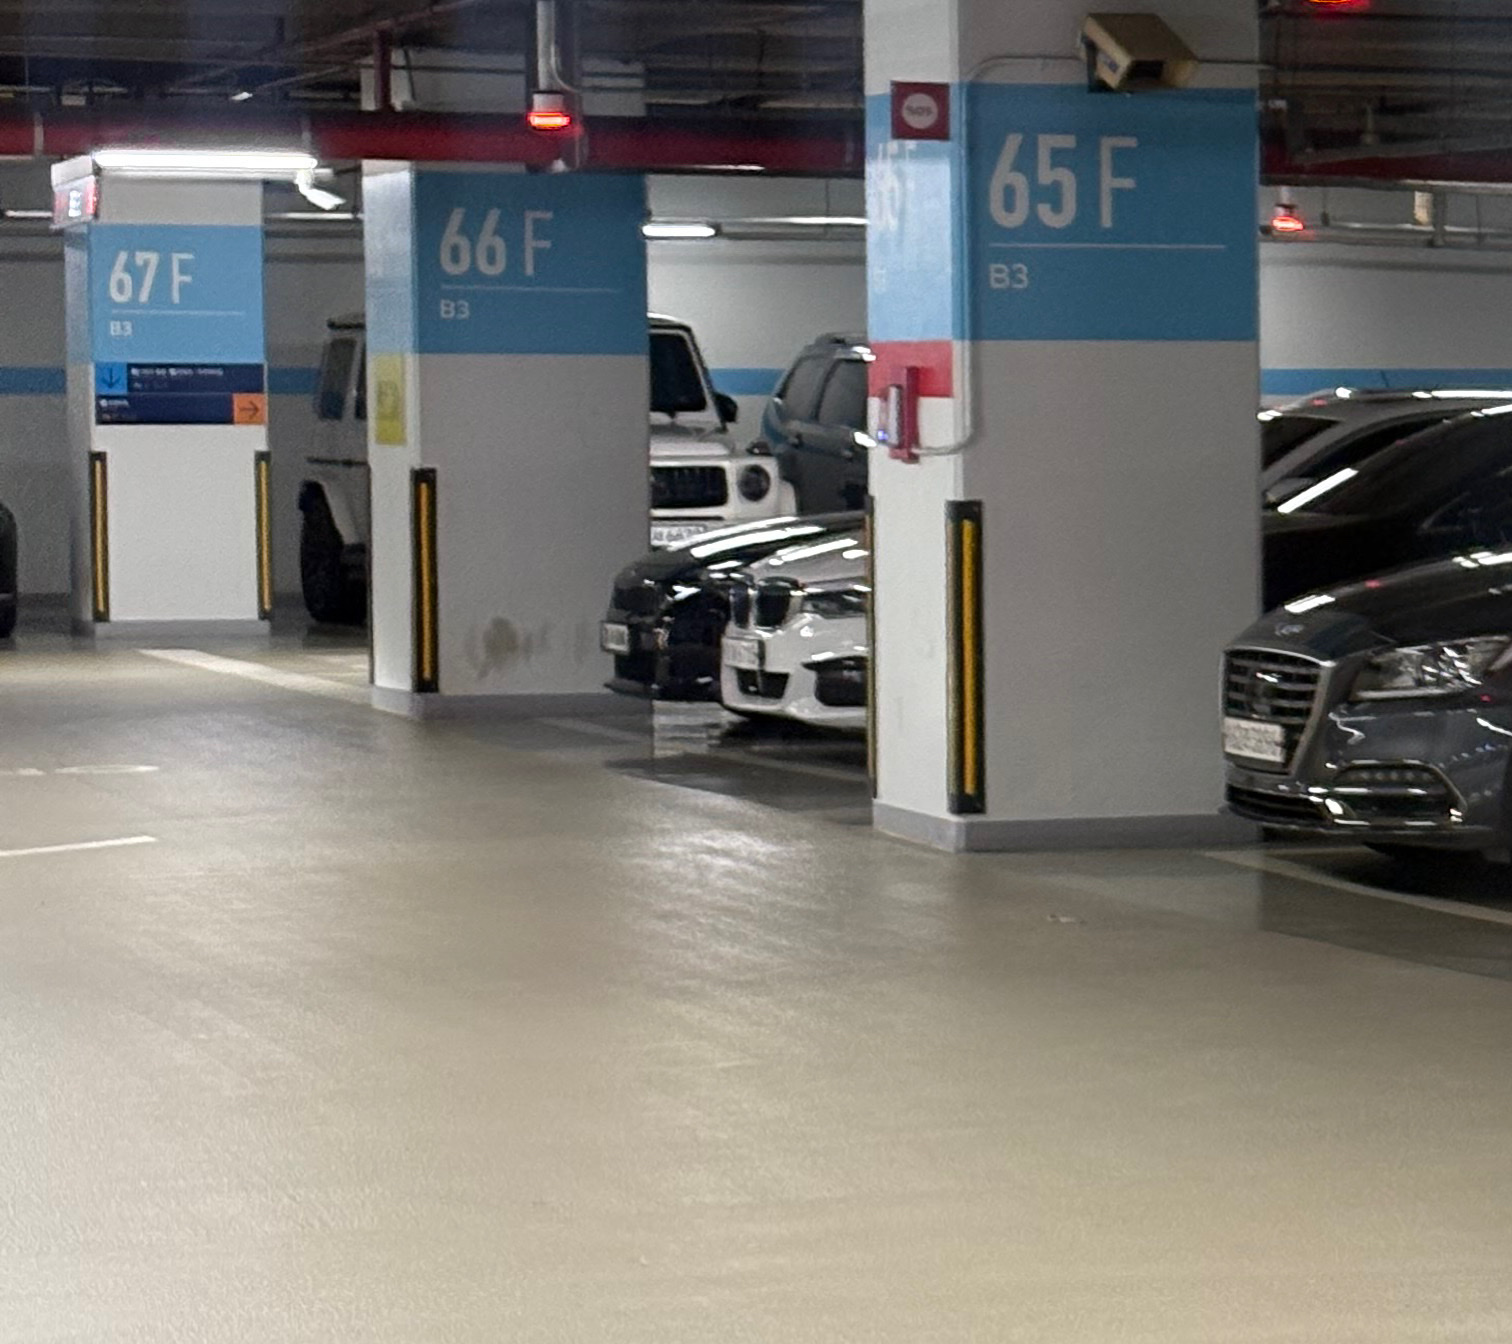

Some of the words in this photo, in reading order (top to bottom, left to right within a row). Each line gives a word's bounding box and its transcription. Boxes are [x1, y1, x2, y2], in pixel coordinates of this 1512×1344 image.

[989, 133, 1077, 229] 65
[1101, 136, 1138, 229] F
[440, 207, 506, 276] 66
[524, 210, 554, 276] F
[109, 250, 159, 303] 67
[171, 252, 195, 304] F
[989, 263, 1028, 289] B3
[109, 320, 133, 337] B3
[440, 299, 470, 319] B3
